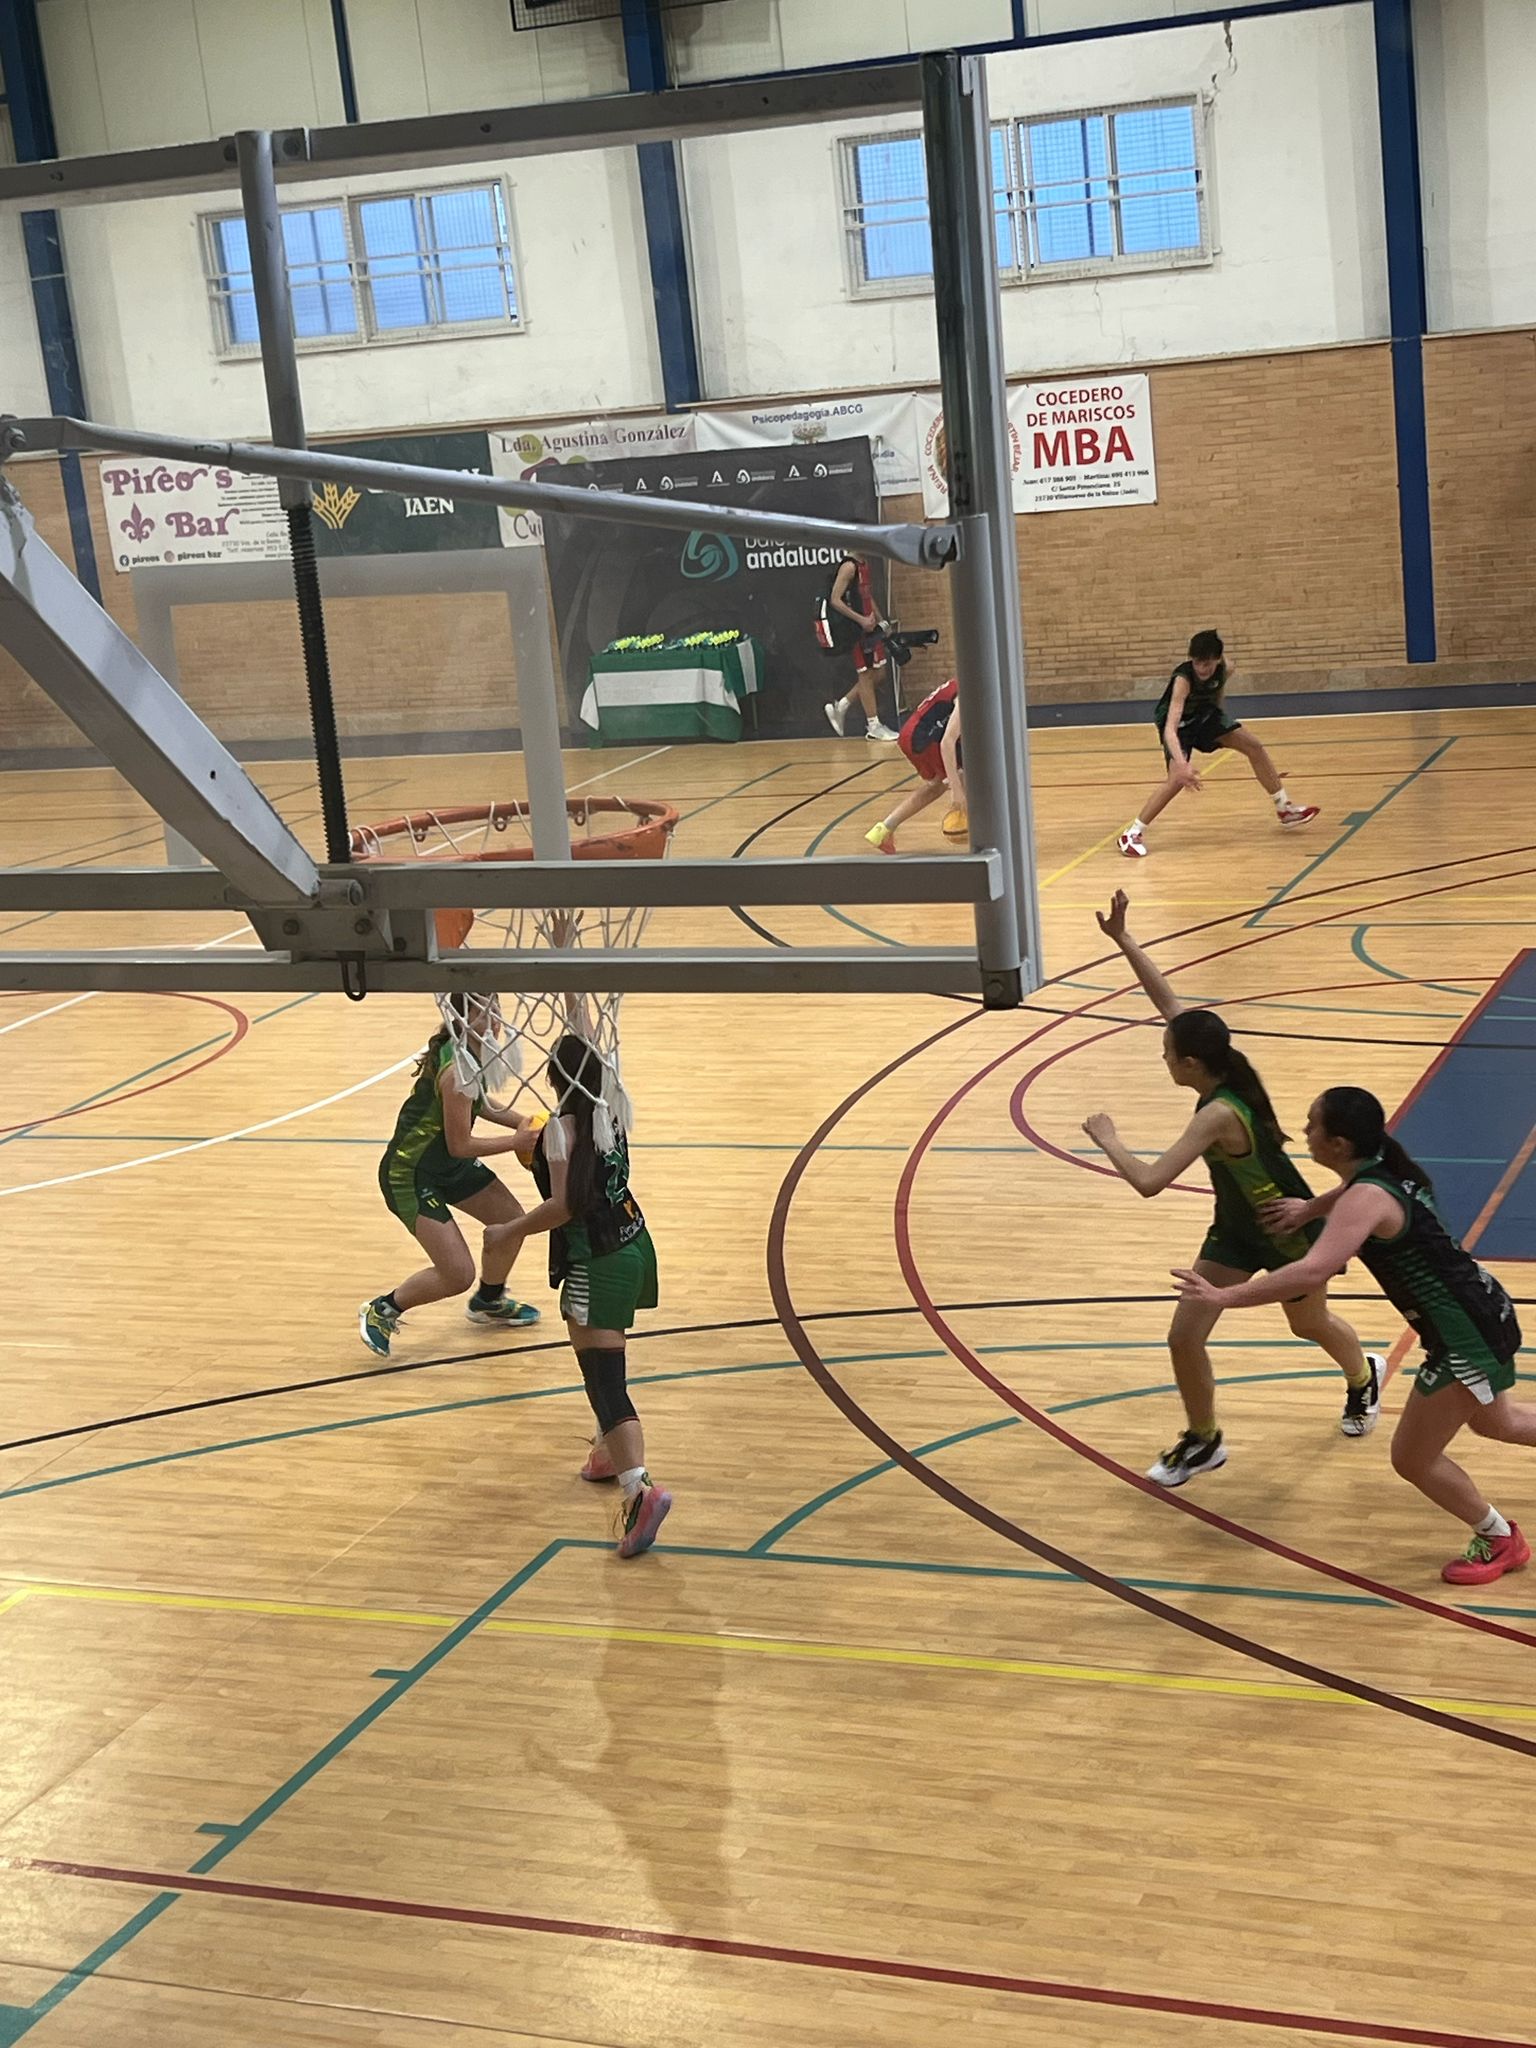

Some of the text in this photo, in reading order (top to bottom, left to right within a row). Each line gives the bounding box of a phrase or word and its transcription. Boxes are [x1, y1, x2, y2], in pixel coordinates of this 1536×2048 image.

[1036, 386, 1123, 407] COCEDERO
[1026, 404, 1135, 428] DE MARISCOS
[502, 424, 687, 454] Lda. Agustina González
[1033, 425, 1135, 469] MBA
[103, 465, 233, 496] Pireo's
[927, 464, 948, 495] REINA
[404, 496, 454, 518] JAEN
[165, 508, 240, 538] Bar
